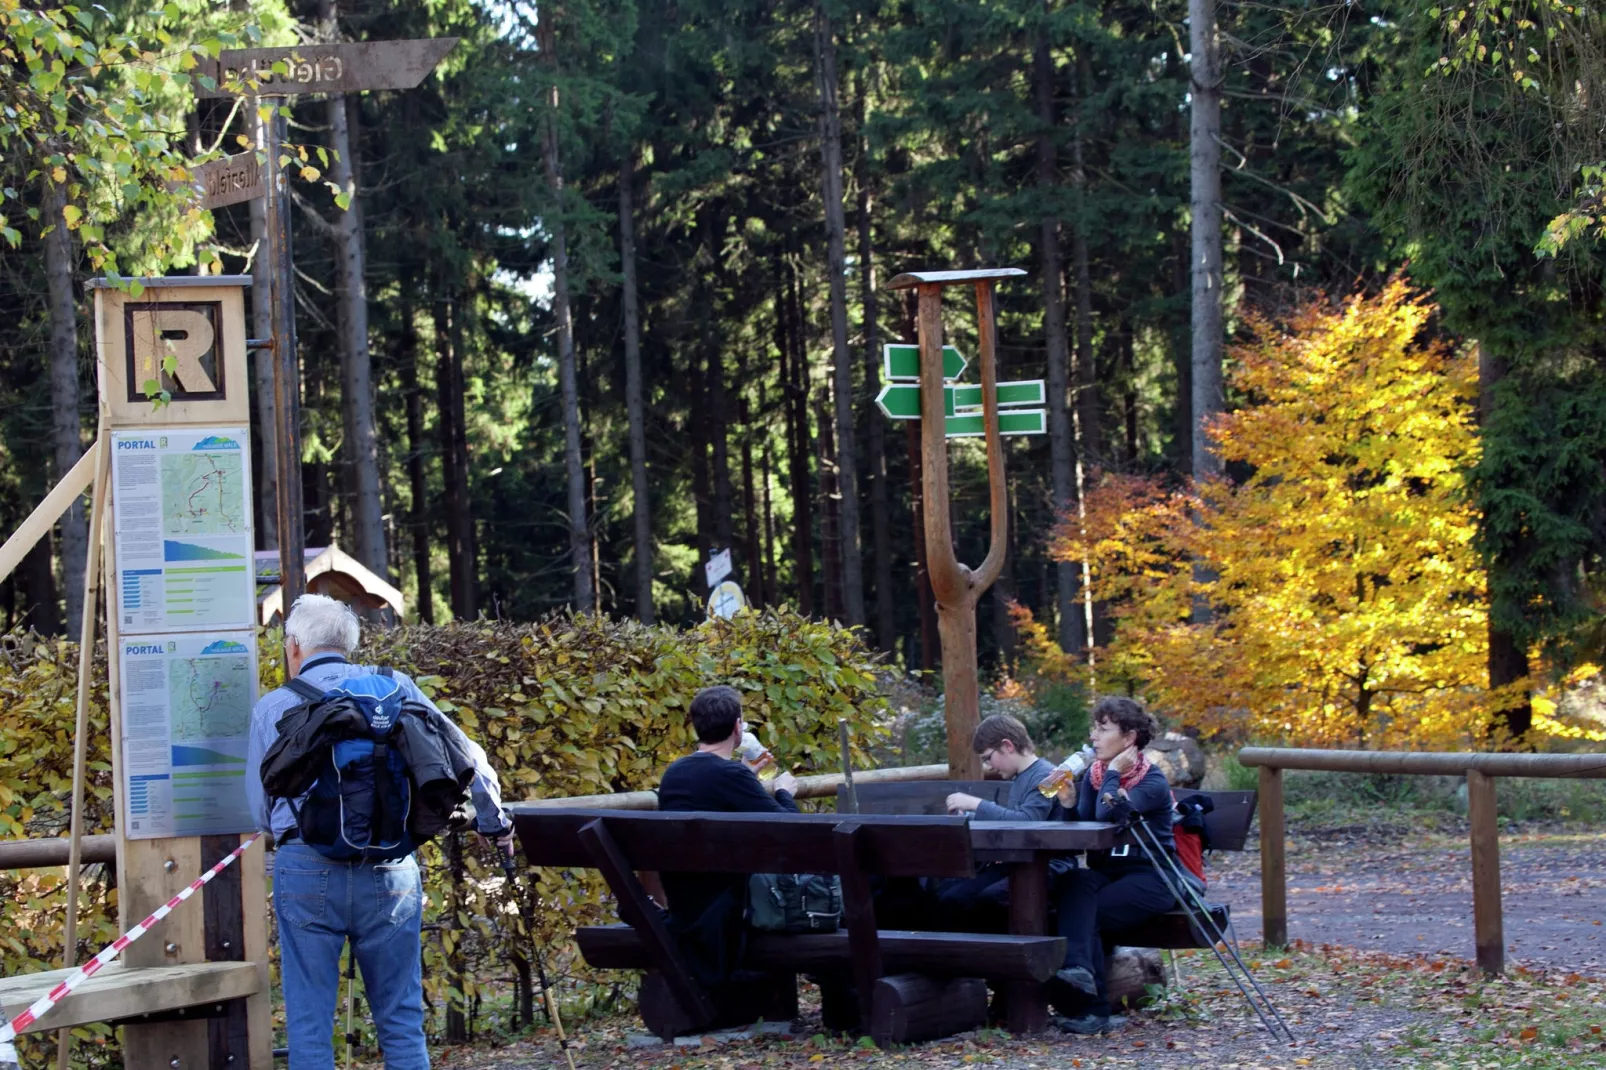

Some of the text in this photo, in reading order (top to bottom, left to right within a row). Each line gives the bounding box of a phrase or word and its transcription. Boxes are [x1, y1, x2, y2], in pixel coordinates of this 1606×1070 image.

[132, 310, 217, 394] R
[118, 440, 156, 450] PORTAL
[126, 645, 164, 655] PORTAL
